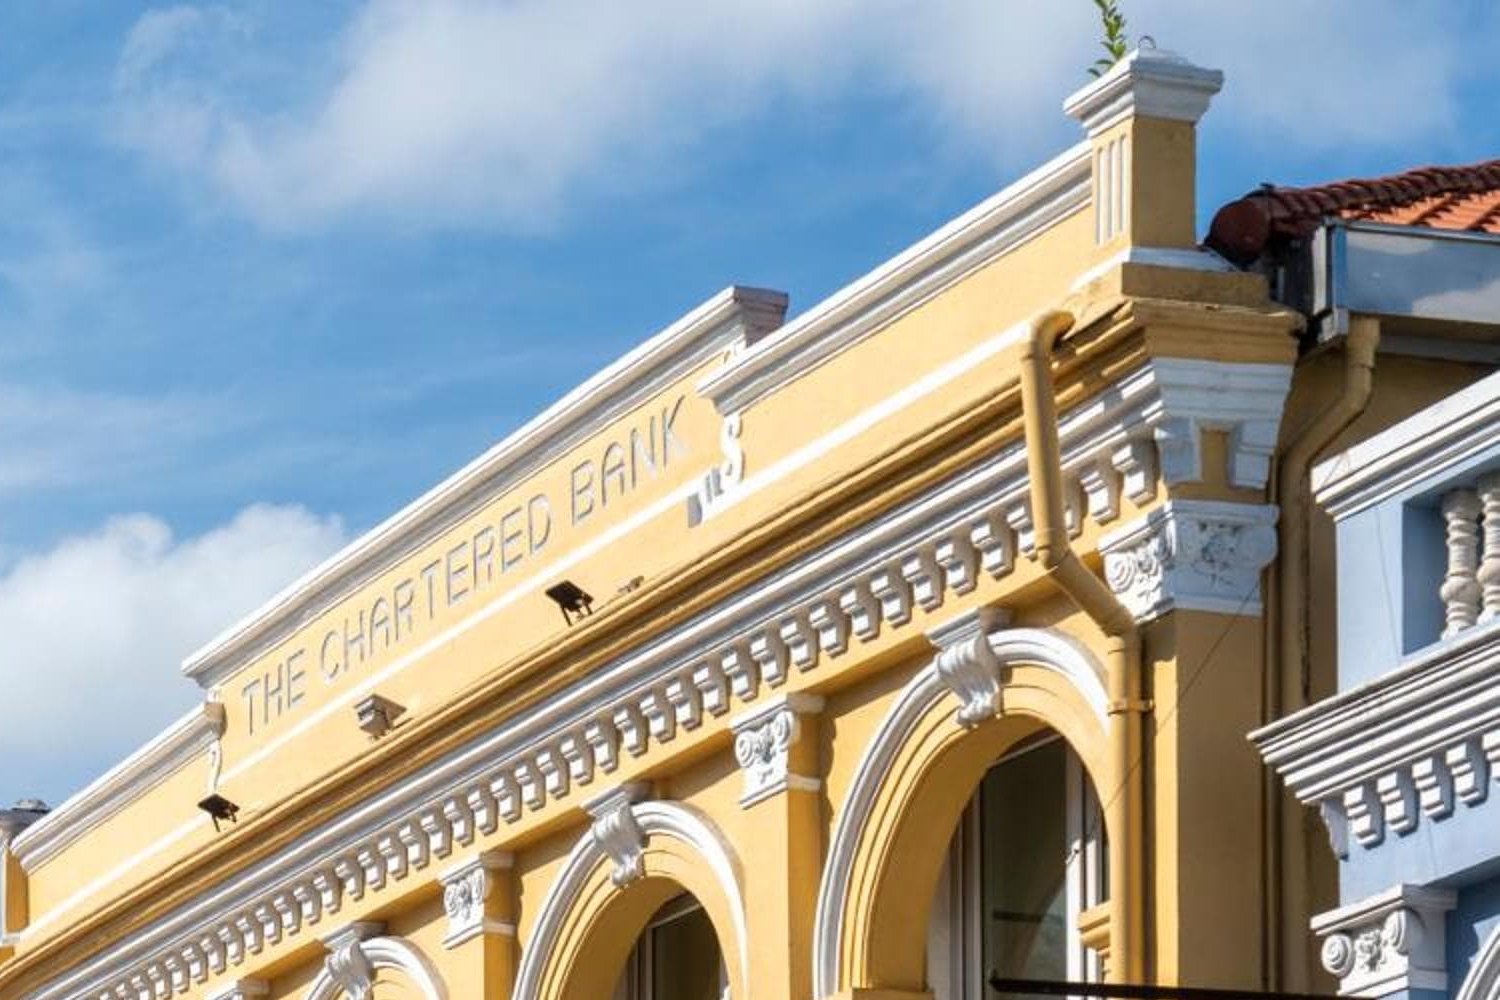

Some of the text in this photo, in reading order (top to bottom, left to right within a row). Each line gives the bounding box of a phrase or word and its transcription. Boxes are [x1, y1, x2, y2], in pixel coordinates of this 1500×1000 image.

[241, 394, 688, 736] THE CHARTERED BANK
